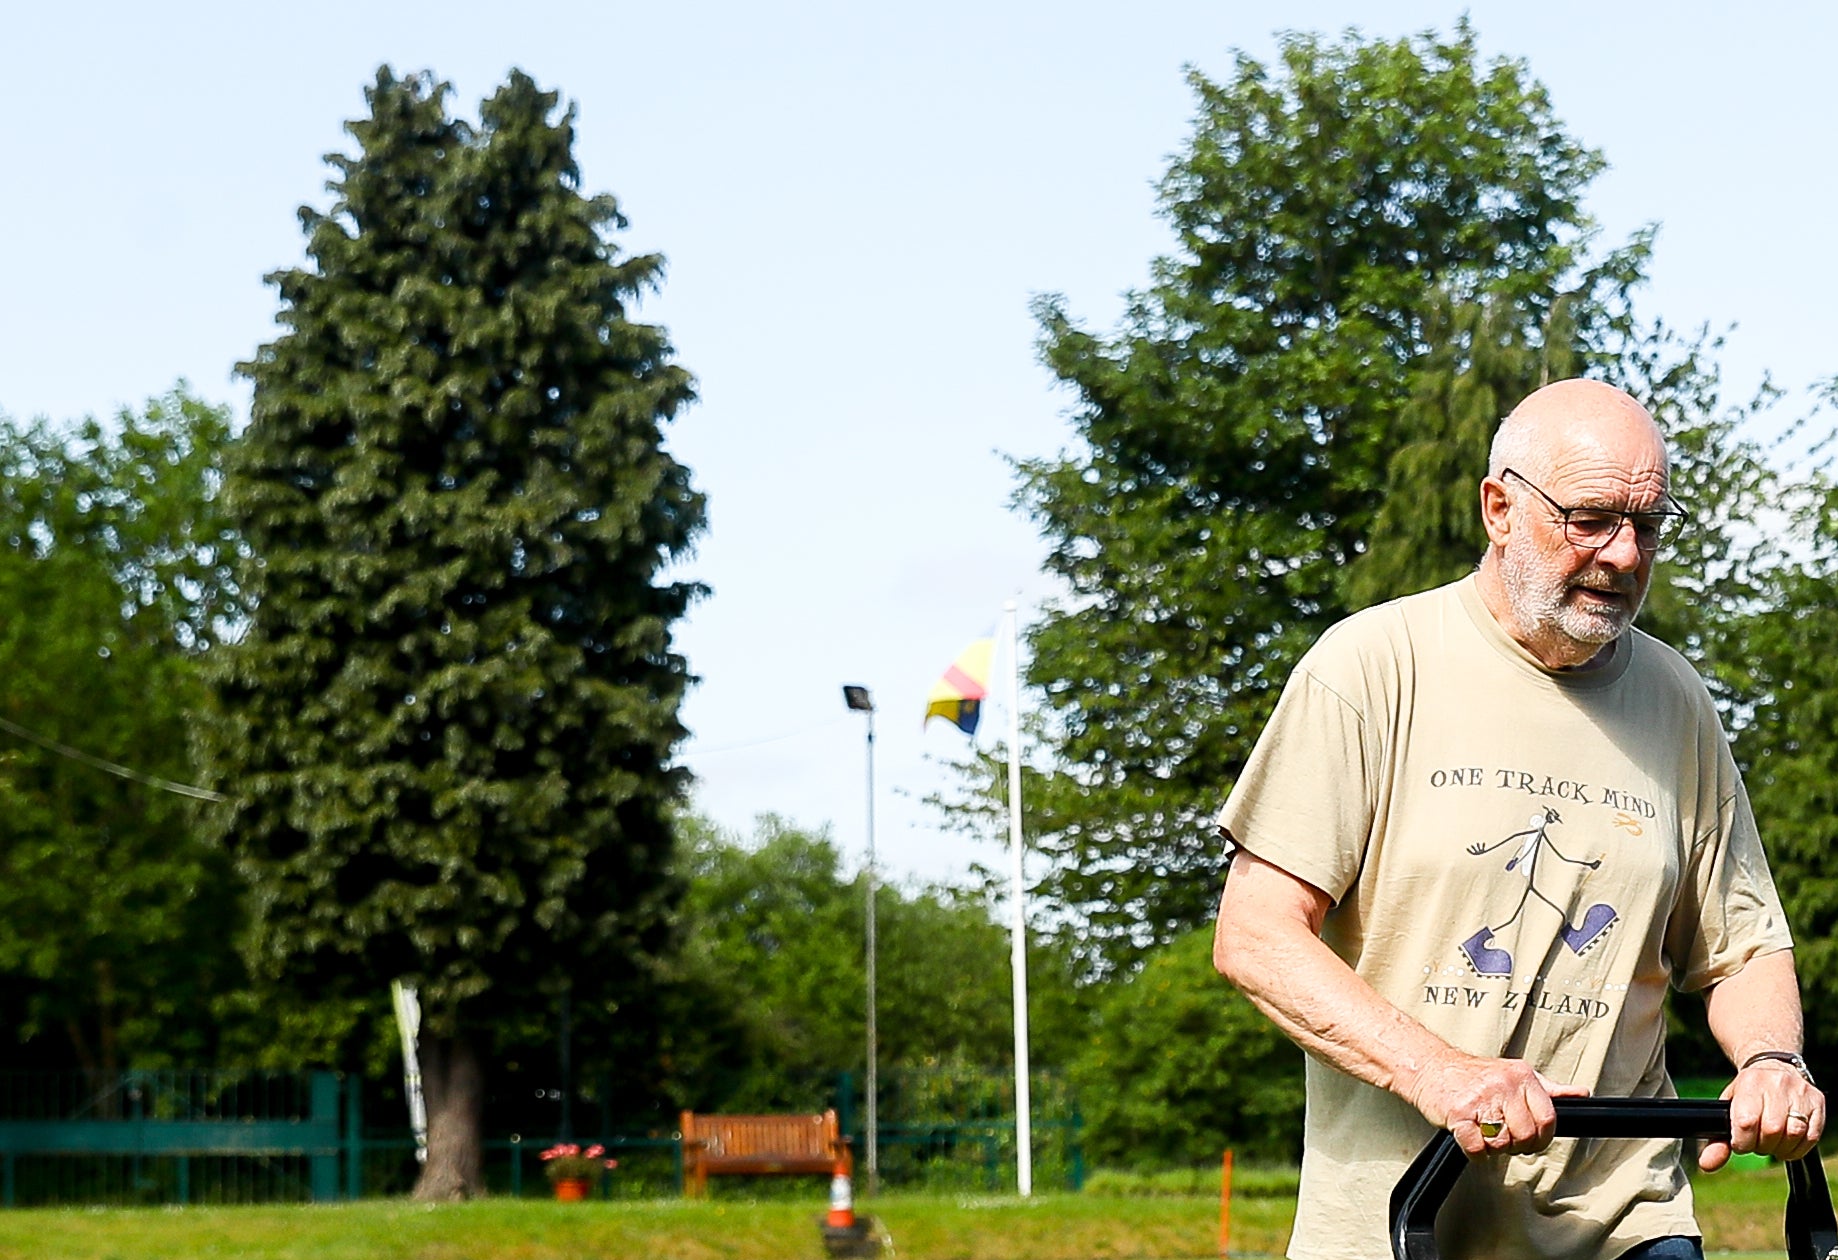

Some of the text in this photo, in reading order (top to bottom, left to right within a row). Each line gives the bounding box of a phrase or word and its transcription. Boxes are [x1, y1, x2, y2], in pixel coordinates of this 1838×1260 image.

[1430, 768, 1483, 787] ONE
[1496, 769, 1593, 805] TRACK
[1424, 986, 1610, 1019] NEW ZLAND
